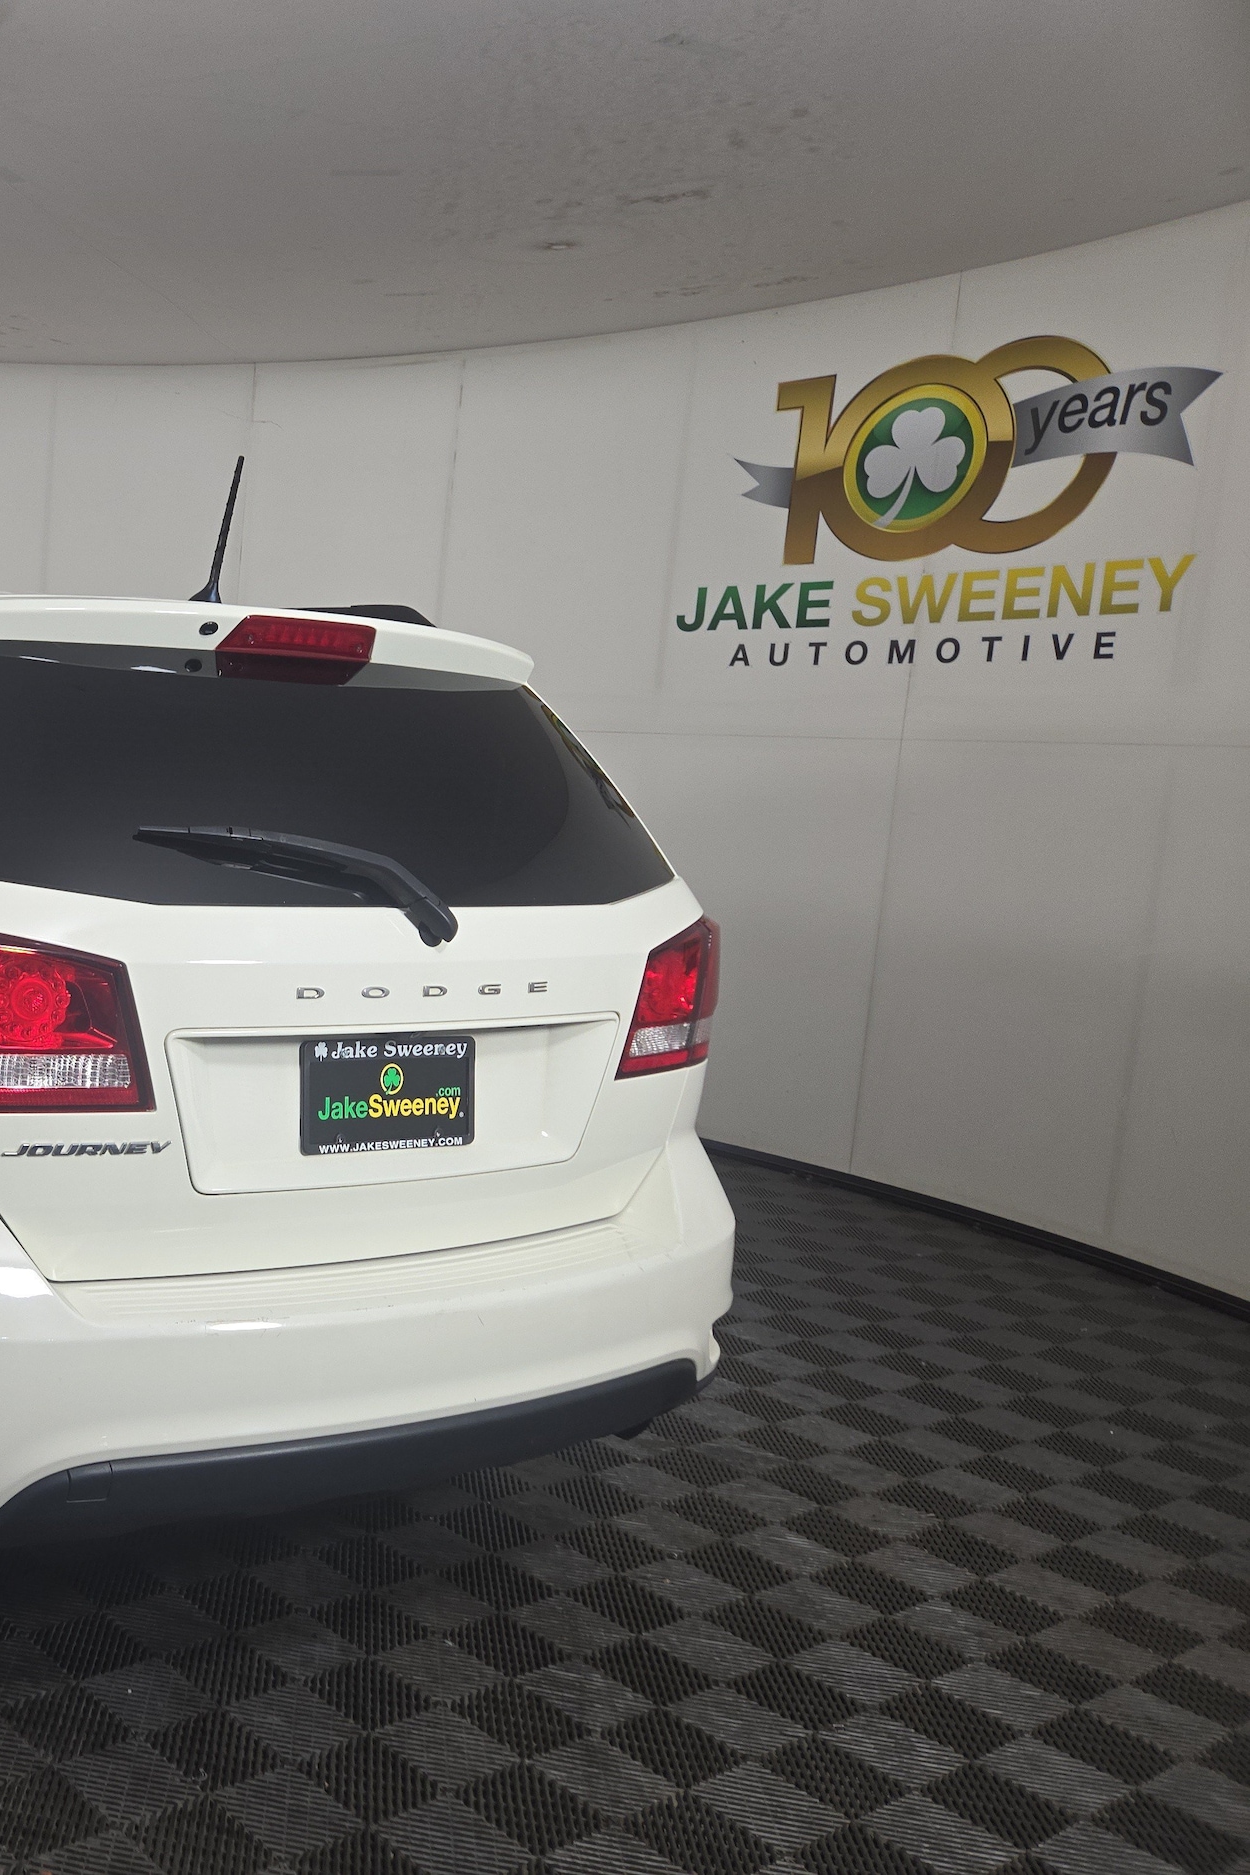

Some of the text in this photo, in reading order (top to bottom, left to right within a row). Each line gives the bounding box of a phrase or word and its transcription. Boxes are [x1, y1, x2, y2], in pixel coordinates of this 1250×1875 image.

[1024, 379, 1173, 455] years
[676, 553, 1198, 633] JAKE SWEENEY
[729, 631, 1117, 667] AUTOMOTIVE
[295, 981, 549, 1000] DODGE
[331, 1040, 468, 1059] Jake Sweeney
[0, 1140, 172, 1157] JOURNEY
[318, 1136, 463, 1154] WWW.JAKESWEENEY.COM
